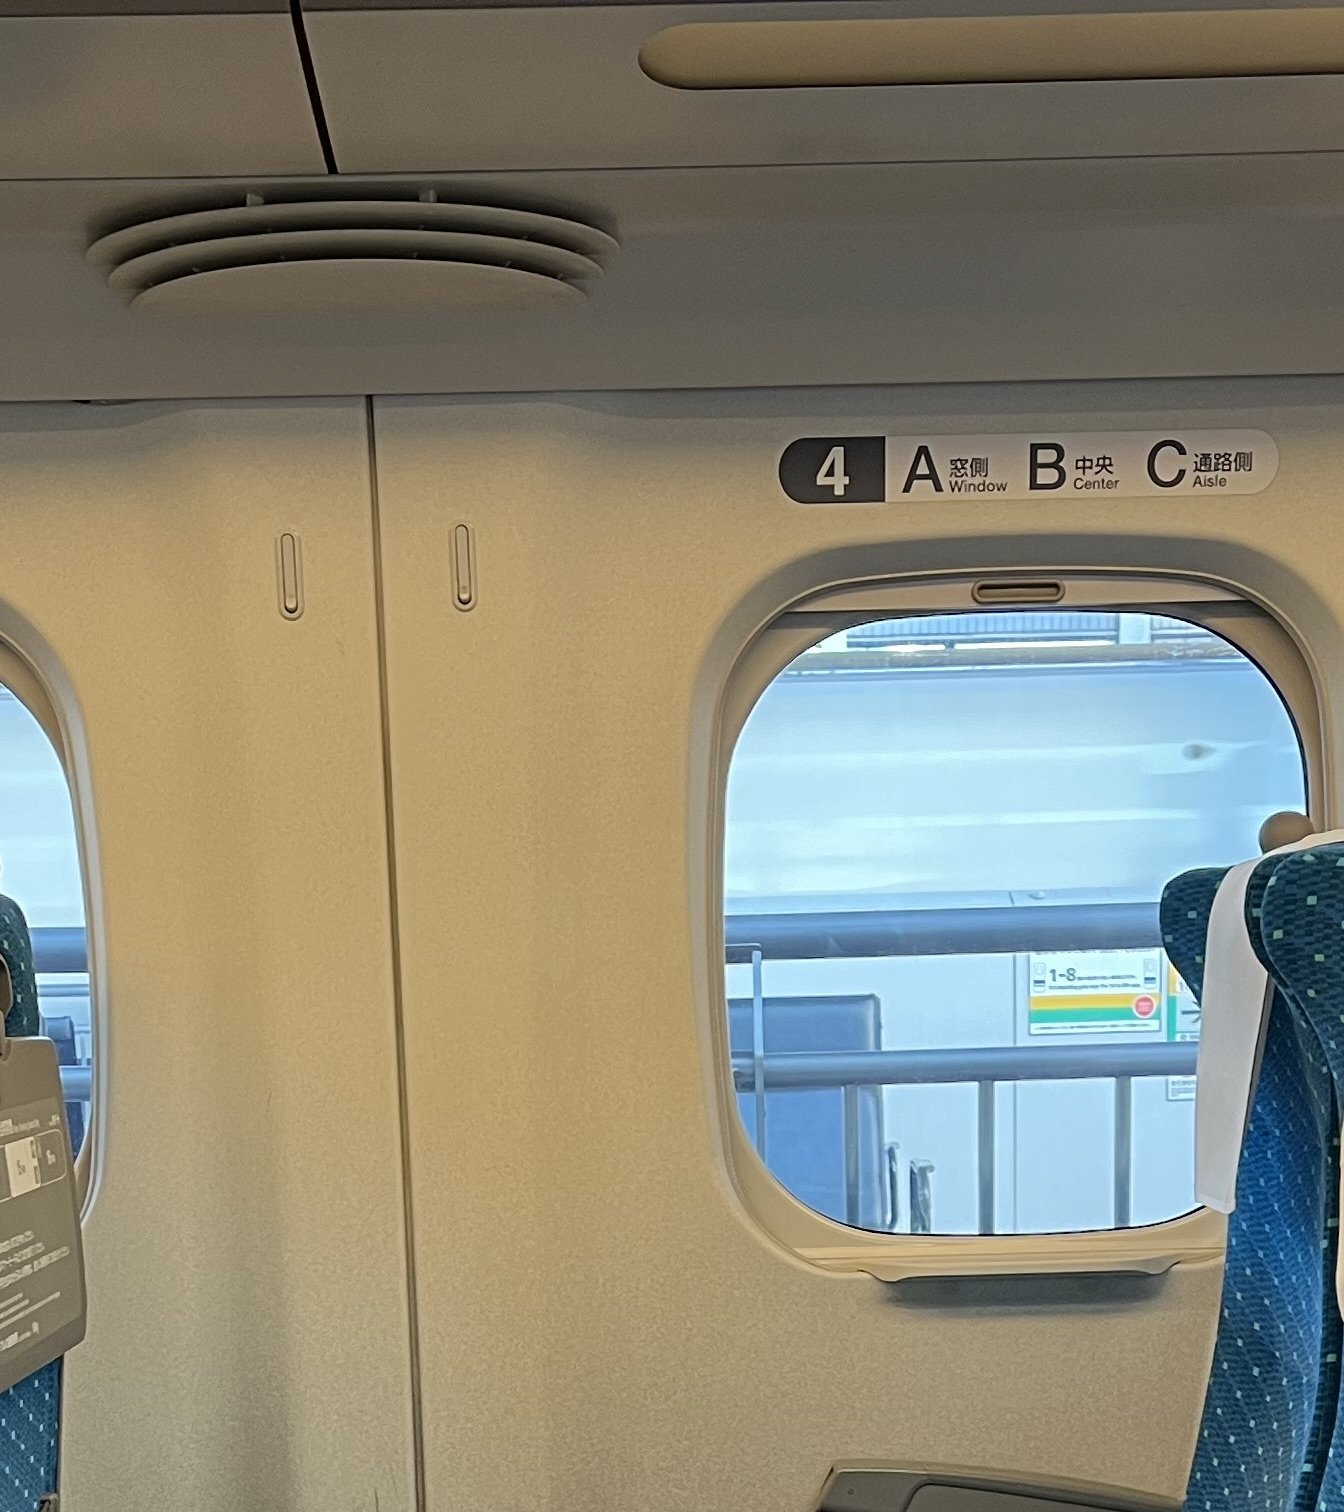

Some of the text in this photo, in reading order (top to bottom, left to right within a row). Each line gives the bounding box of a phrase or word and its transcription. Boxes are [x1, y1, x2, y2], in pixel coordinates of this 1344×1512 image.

[815, 439, 1253, 496] 4 A 窓側 B 中央 C 通路側
[948, 474, 1228, 494] Window Center Aisle
